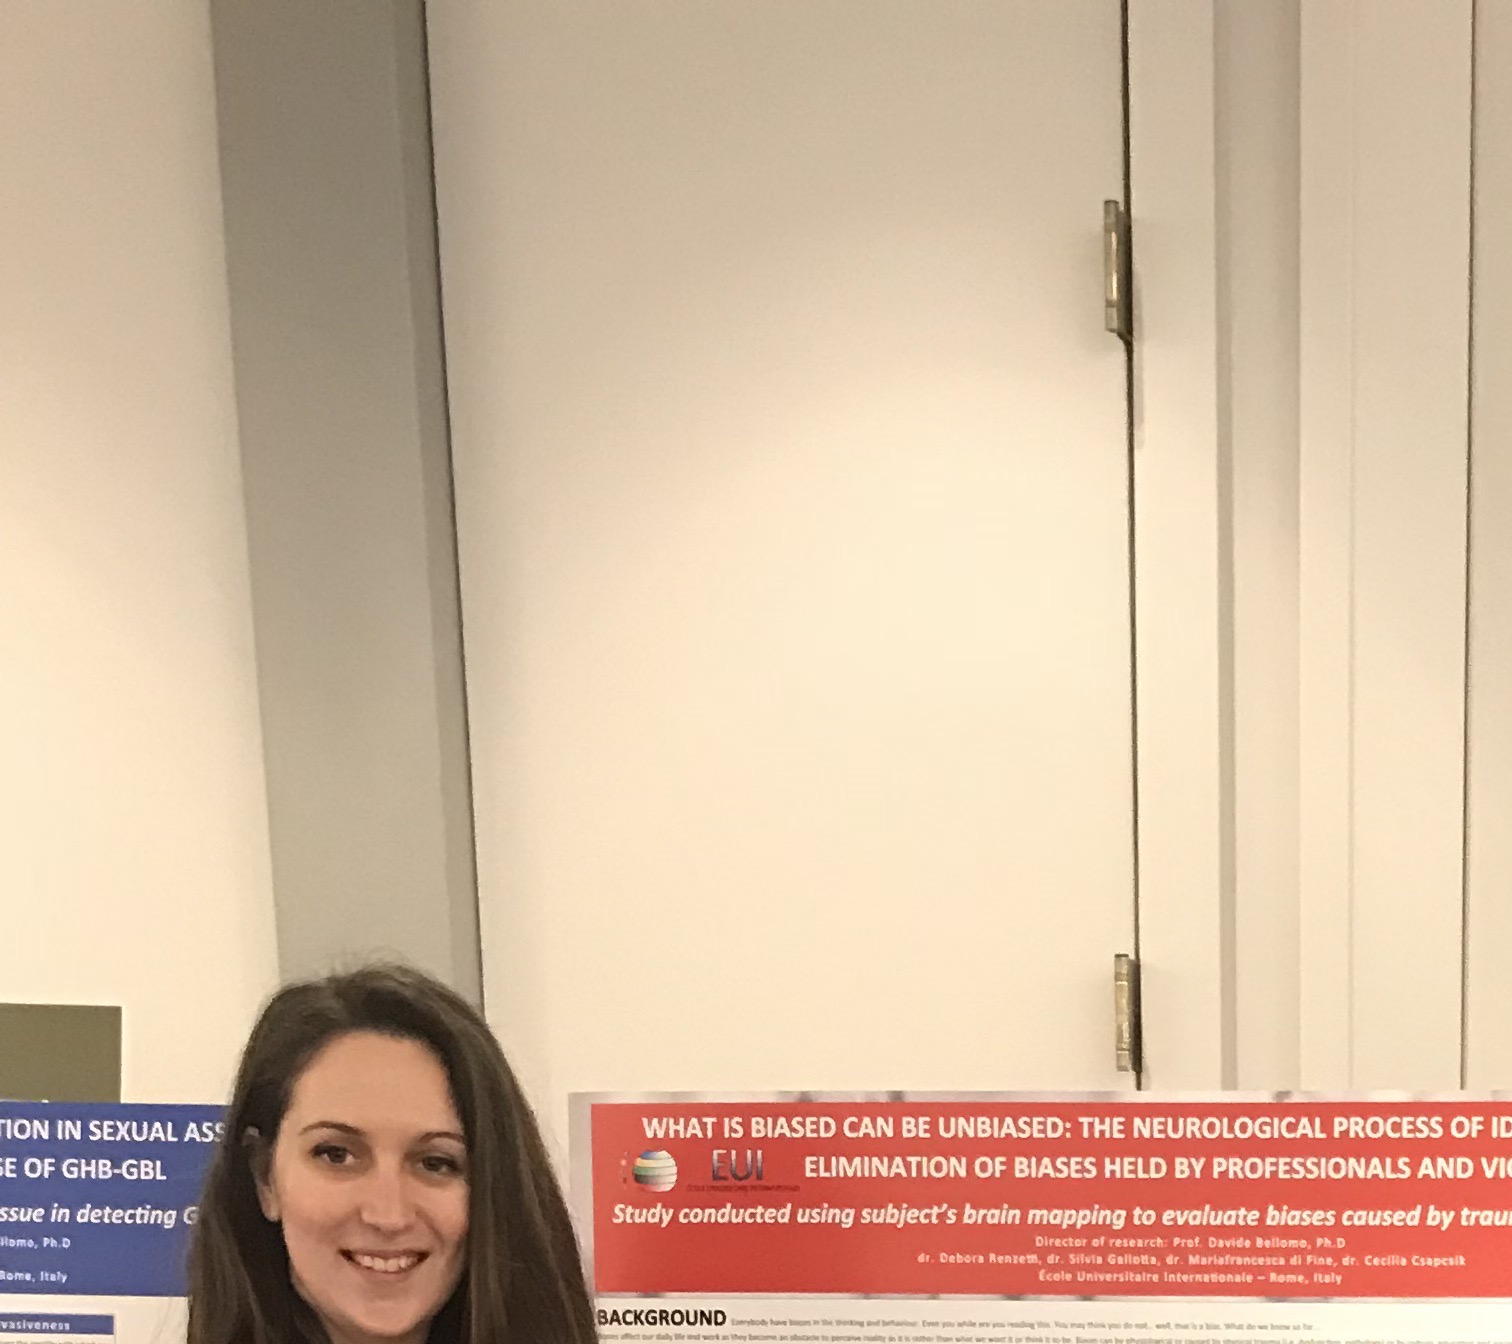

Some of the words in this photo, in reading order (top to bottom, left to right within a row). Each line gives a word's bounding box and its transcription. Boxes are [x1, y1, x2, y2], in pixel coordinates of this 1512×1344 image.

[56, 1119, 81, 1140] IN
[88, 1120, 178, 1141] SEXUAL
[641, 1117, 717, 1139] WHAT
[723, 1116, 743, 1138] IS
[750, 1116, 836, 1138] BIASED
[842, 1116, 894, 1138] CAN
[901, 1116, 930, 1138] BE
[938, 1116, 1071, 1138] UNBIASED:
[1077, 1116, 1125, 1138] THE
[1133, 1116, 1327, 1138] NEUROLOGICAL
[1333, 1116, 1443, 1138] PROCESS
[1450, 1115, 1484, 1138] OF
[0, 1157, 17, 1177] E
[24, 1157, 55, 1178] OF
[61, 1158, 167, 1180] GHB-GBL
[711, 1148, 764, 1182] EUI
[804, 1156, 966, 1178] ELIMINATION
[974, 1156, 1006, 1178] OF
[1014, 1156, 1097, 1178] BIASES
[1104, 1156, 1167, 1178] HELD
[1174, 1156, 1206, 1178] BY
[1212, 1156, 1411, 1179] PROFESSIONALS
[1416, 1156, 1474, 1179] AND
[50, 1202, 70, 1222] in
[76, 1204, 177, 1227] detecting
[612, 1202, 674, 1227] Study
[678, 1202, 792, 1223] conducted
[796, 1202, 855, 1228] using
[962, 1202, 1020, 1224] brain
[1026, 1204, 1126, 1229] mapping
[1132, 1206, 1156, 1225] to
[1161, 1204, 1260, 1226] evaluate
[1265, 1204, 1336, 1226] biases
[1341, 1204, 1422, 1226] caused
[1426, 1204, 1455, 1231] by
[594, 1305, 726, 1330] BACKGROUND
